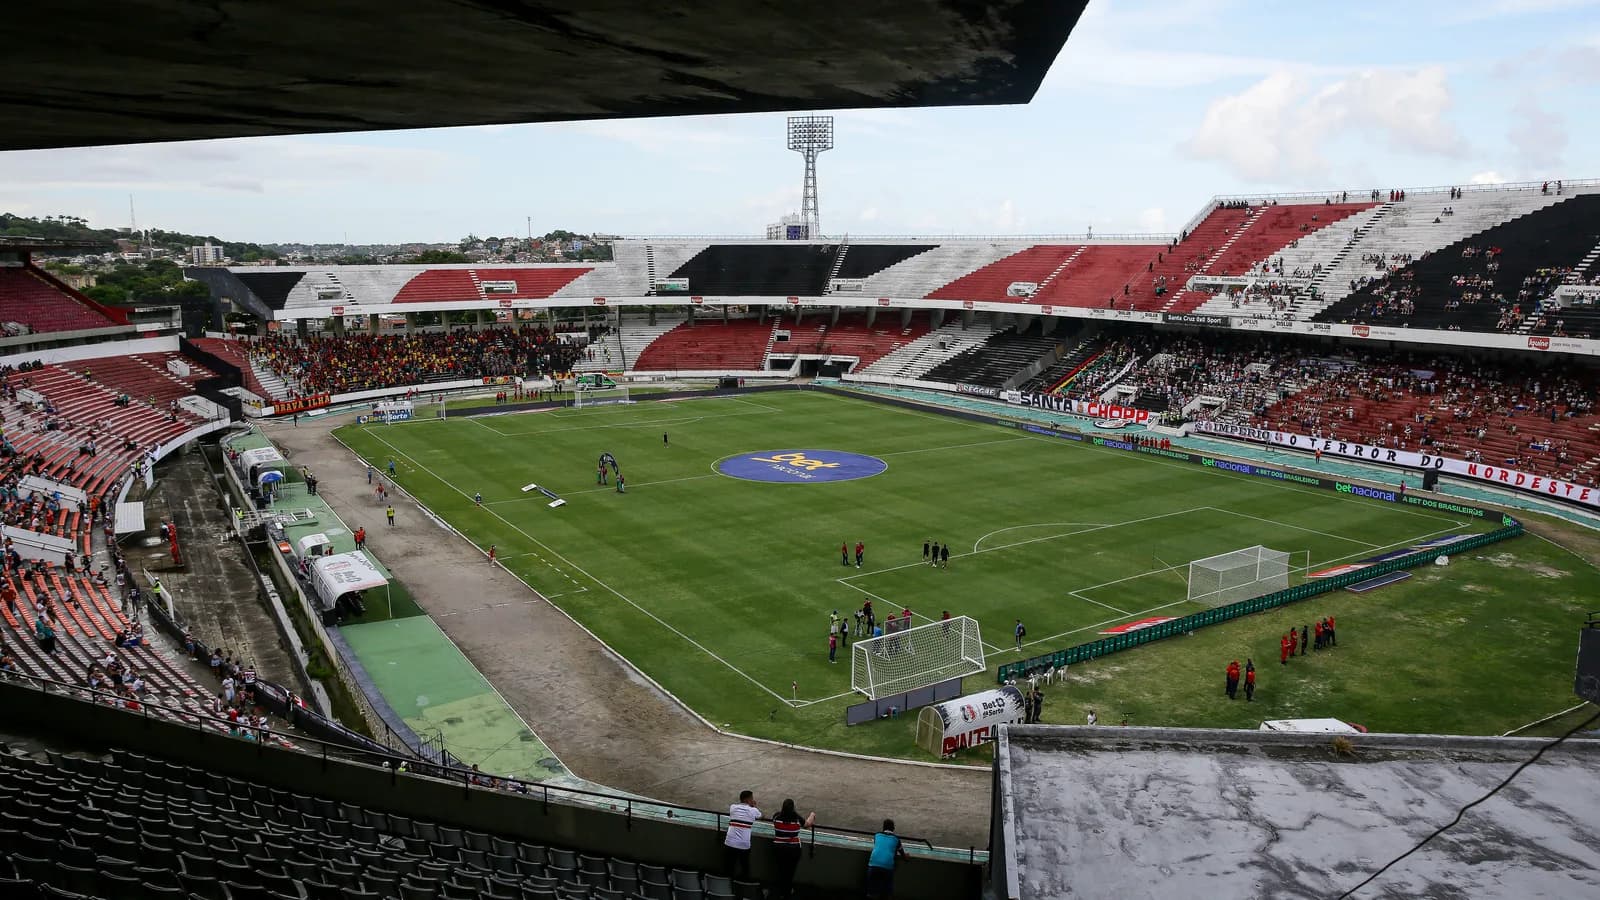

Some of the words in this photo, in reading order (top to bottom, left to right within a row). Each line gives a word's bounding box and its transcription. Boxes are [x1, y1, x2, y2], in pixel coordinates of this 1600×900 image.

[1206, 317, 1222, 325] Sport
[274, 400, 304, 412] BRAVA
[308, 395, 330, 407] ILHA
[1021, 393, 1073, 412] SANTA
[1087, 402, 1149, 423] CHOPP
[1201, 457, 1250, 474] betnacional
[1271, 471, 1283, 479] DOS
[1283, 472, 1320, 486] BRASILEIROS
[1309, 437, 1400, 462] TERROR
[1421, 455, 1444, 469] DO
[1467, 464, 1591, 500] NORDESTE
[1335, 481, 1396, 502] betnacional
[1408, 497, 1422, 505] BET
[1422, 499, 1437, 508] DOS
[1438, 502, 1484, 517] BRASILEIROS
[982, 701, 997, 710] Bet
[988, 708, 1004, 717] Sorte
